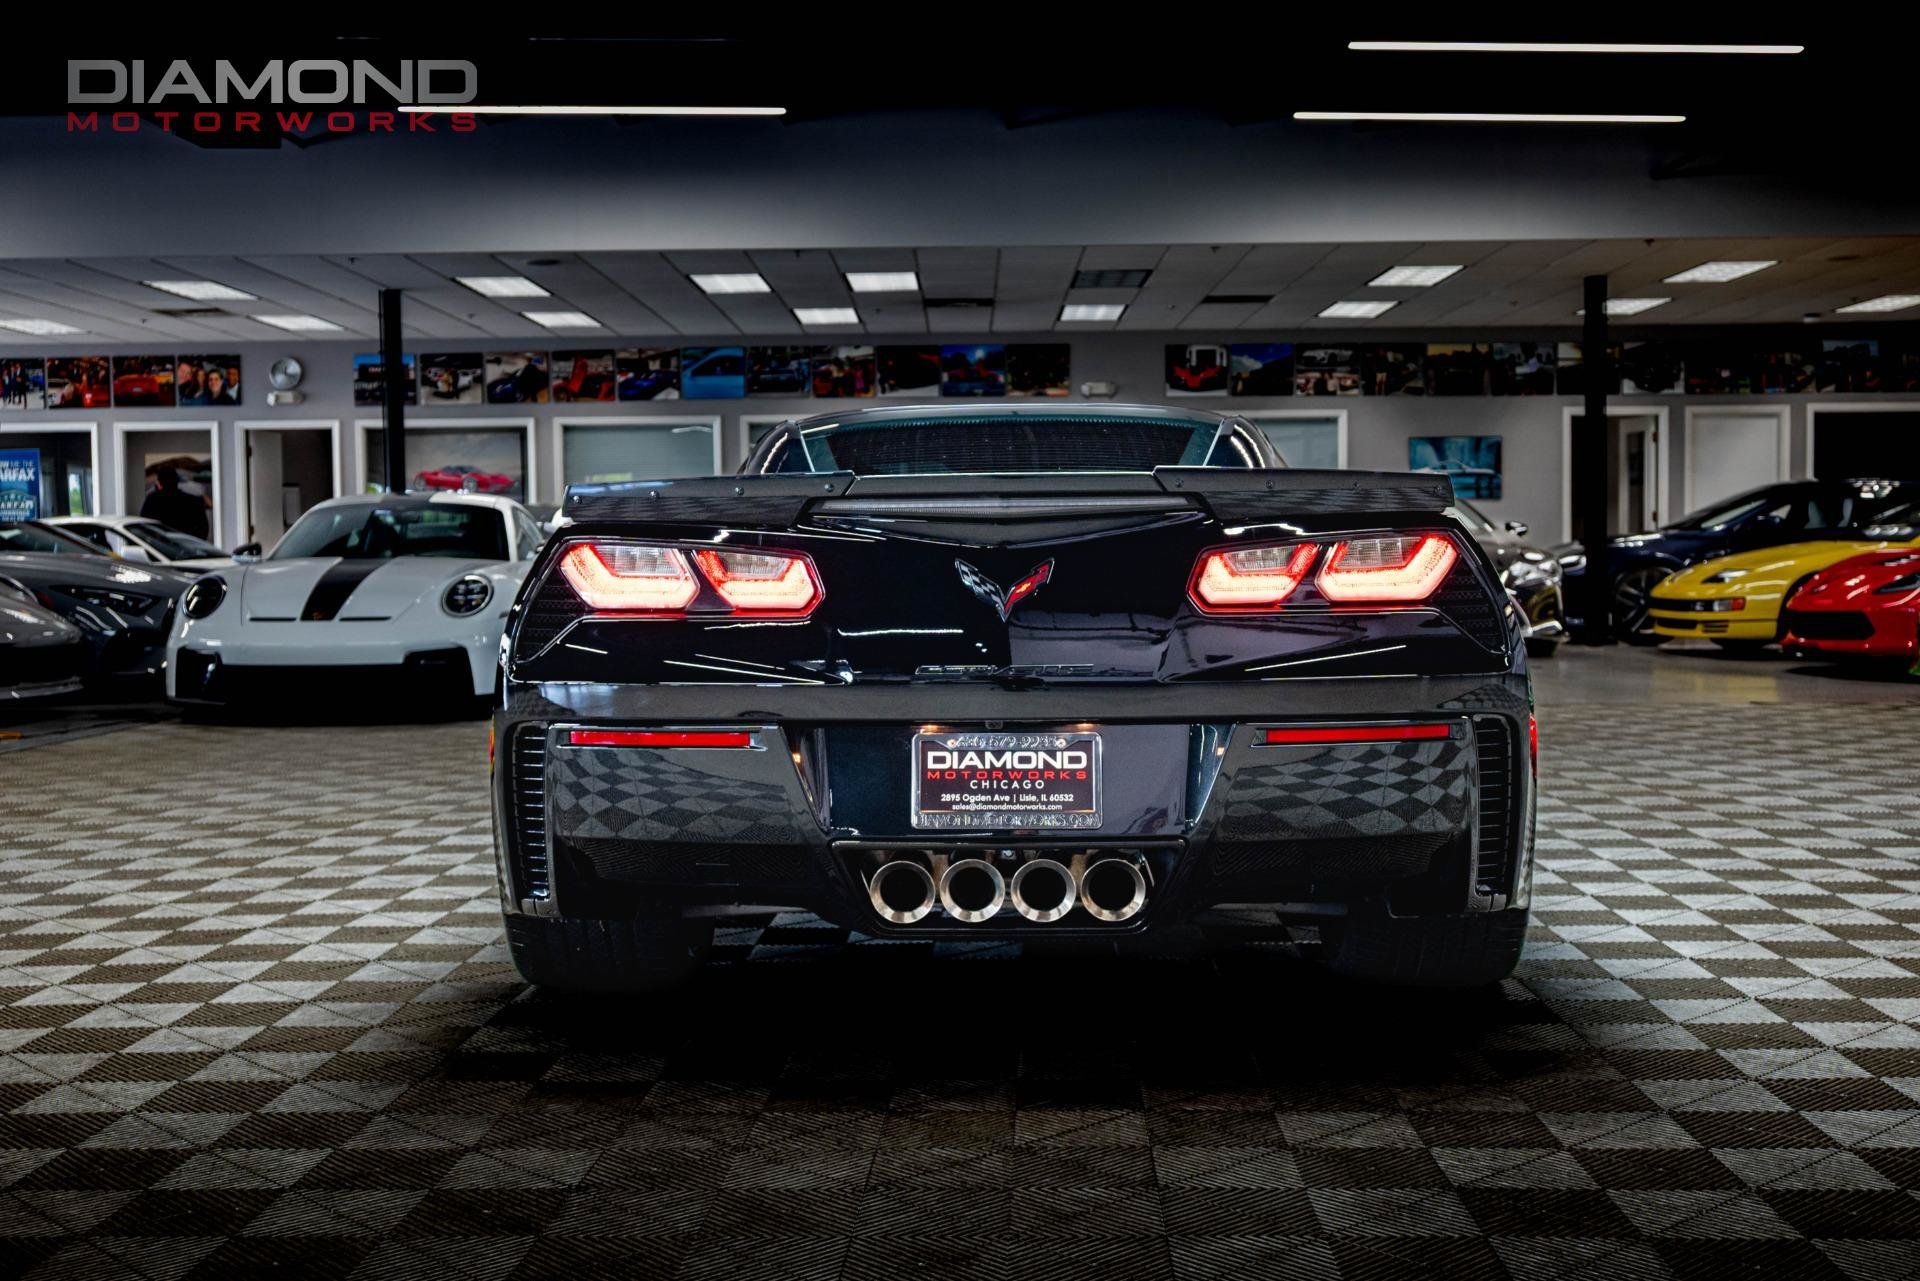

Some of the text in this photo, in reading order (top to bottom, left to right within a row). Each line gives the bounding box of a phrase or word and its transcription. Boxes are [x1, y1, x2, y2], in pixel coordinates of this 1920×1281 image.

[0, 468, 35, 482] ARFAX
[927, 751, 1088, 769] DIAMOND
[927, 771, 1087, 780] MOTORWORKS
[970, 780, 1045, 789] CHICAGO
[941, 794, 960, 802] 2895
[962, 794, 992, 804] Ogden
[993, 794, 1010, 802] Ave
[1041, 794, 1048, 802] IL
[1049, 794, 1074, 802] 60532
[952, 803, 1063, 811] sales@diamondmotorworks.com
